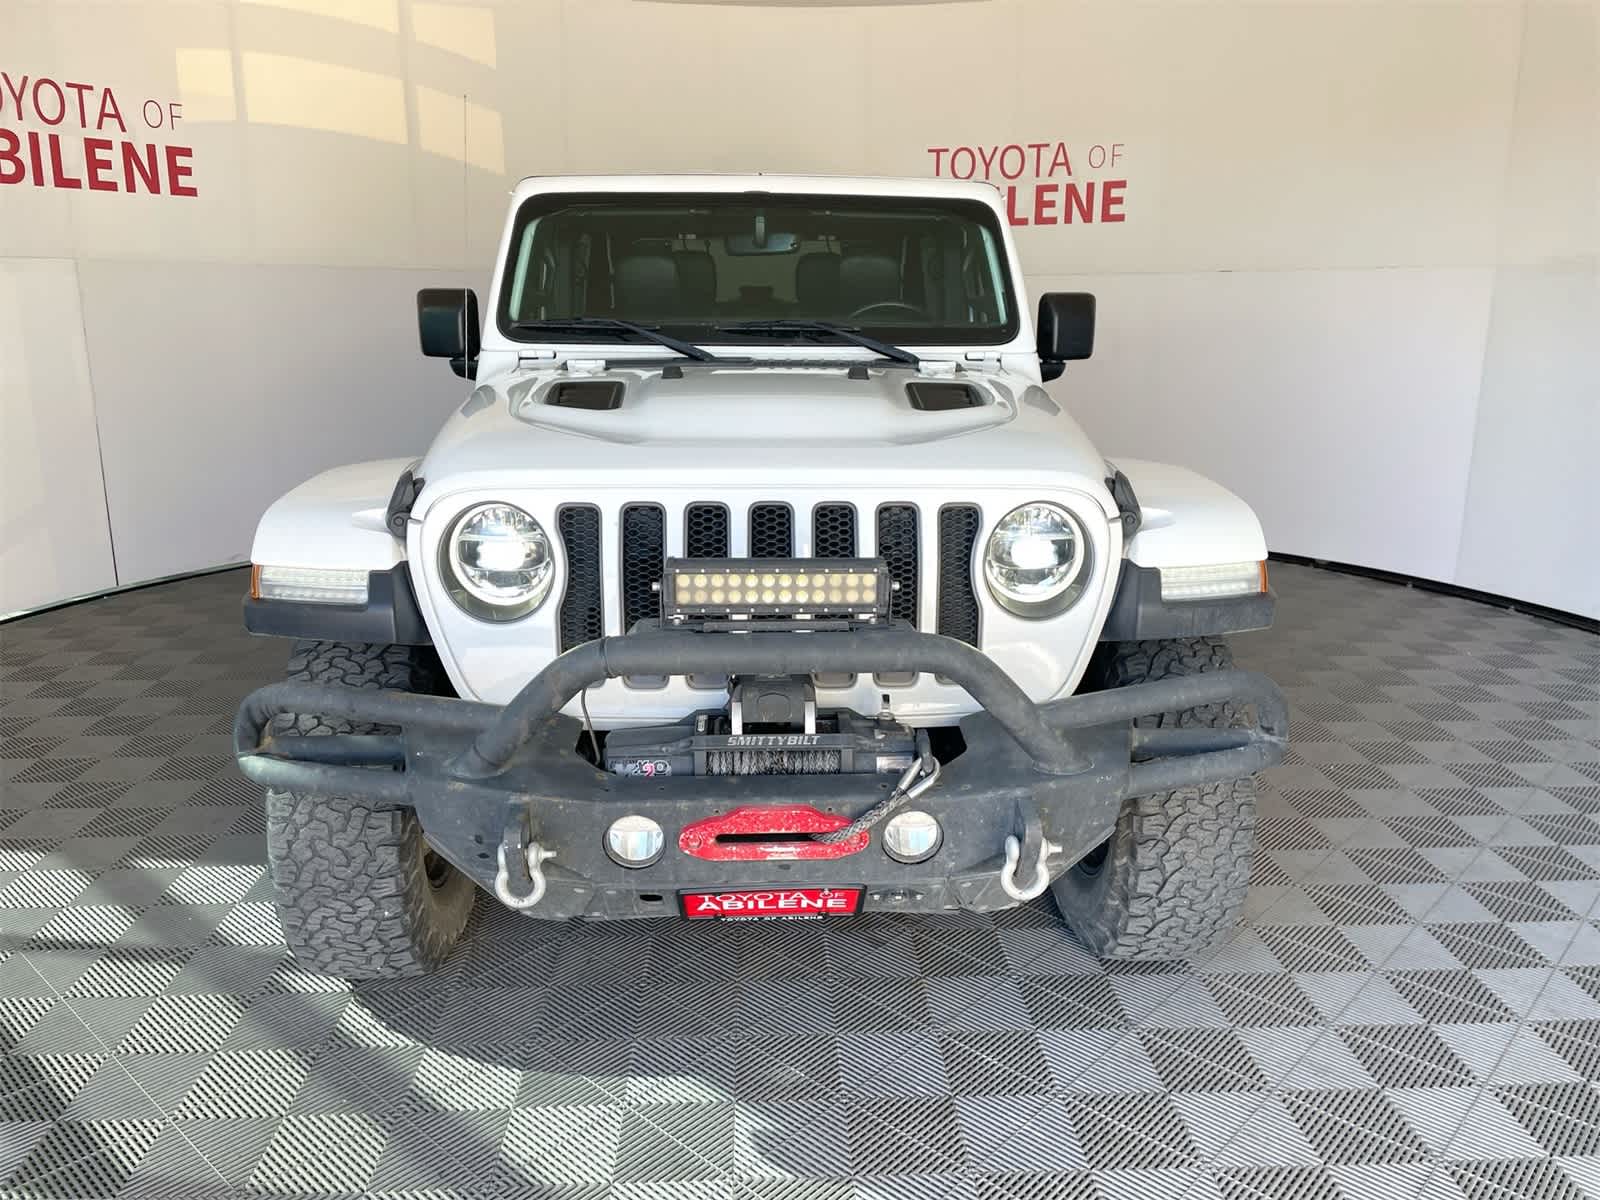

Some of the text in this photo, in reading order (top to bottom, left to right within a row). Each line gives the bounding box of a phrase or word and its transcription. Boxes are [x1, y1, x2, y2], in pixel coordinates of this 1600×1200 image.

[0, 72, 183, 132] YOTA OF
[927, 142, 1125, 180] TOYOTA OF
[1005, 180, 1127, 226] LENE
[727, 735, 821, 746] SMITTYBILT
[696, 898, 848, 911] ABILENE
[697, 890, 845, 903] TOYOTA OF
